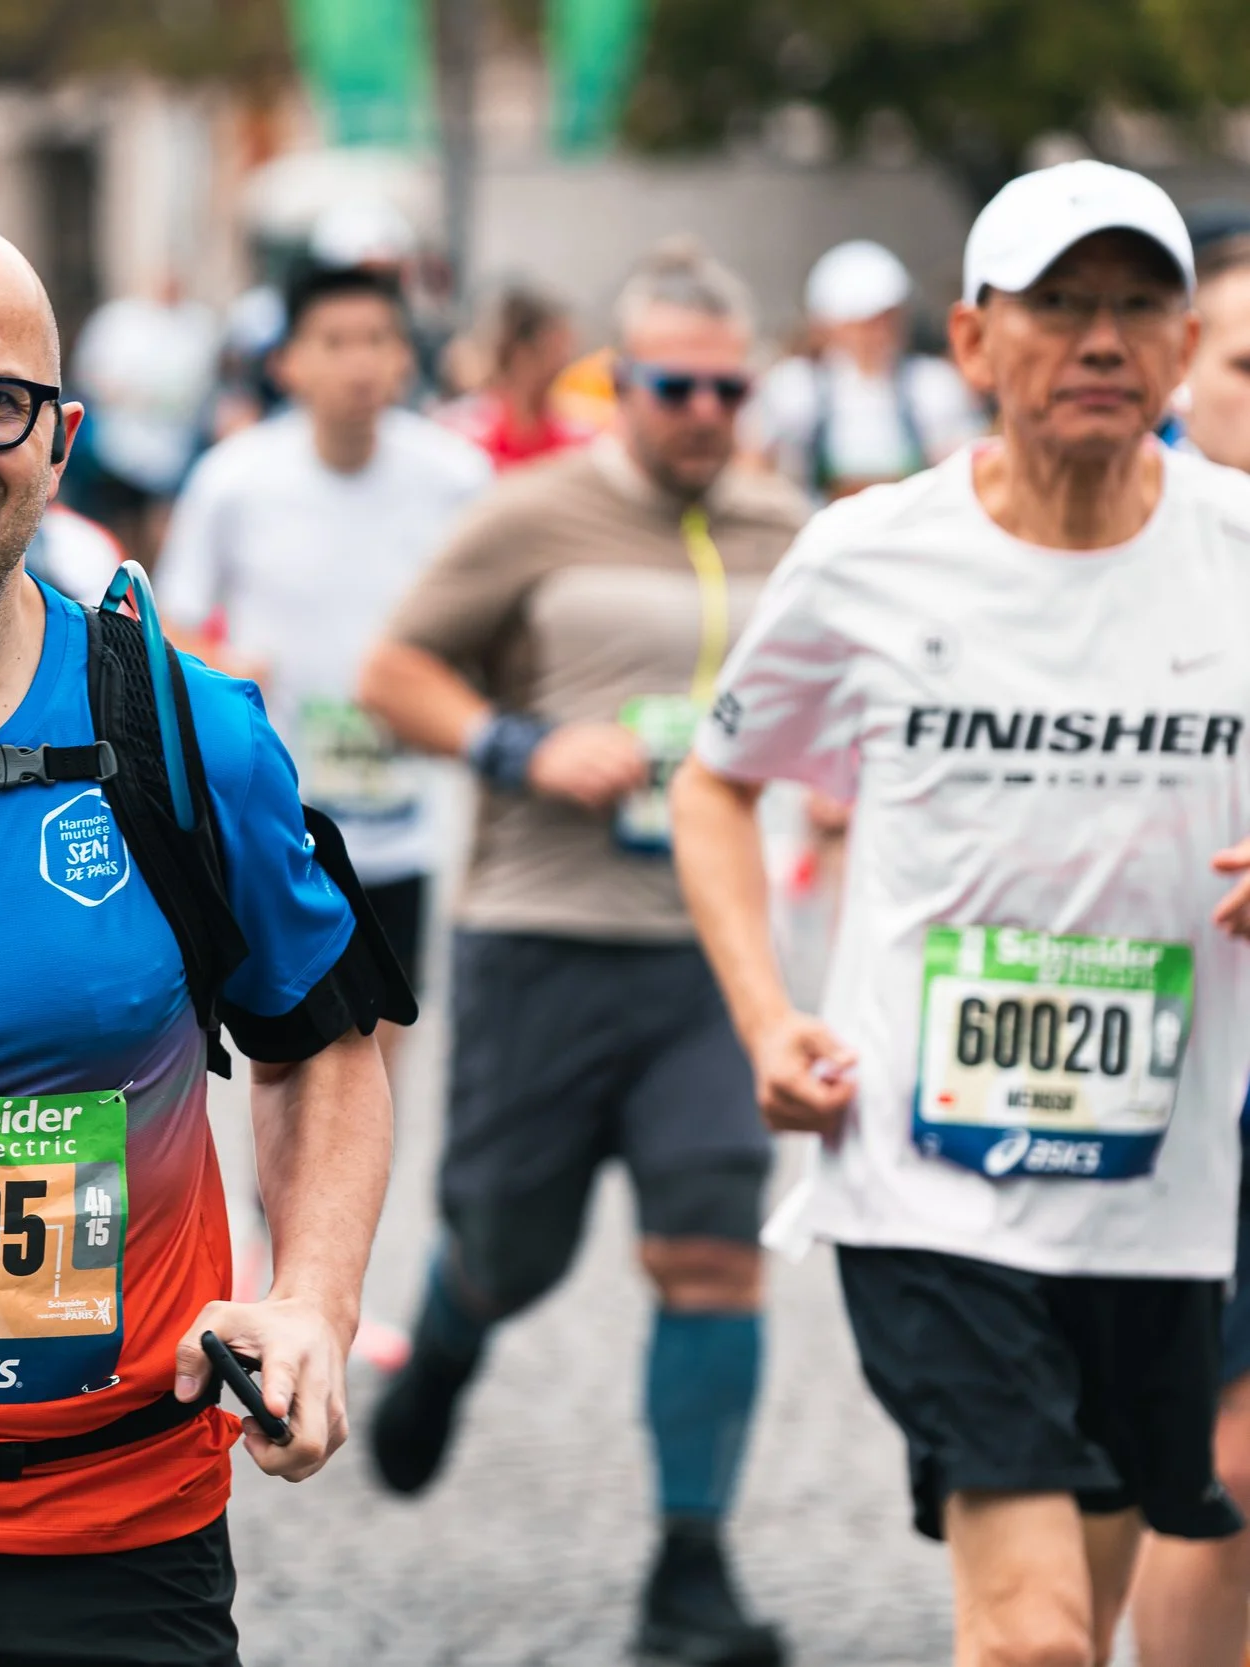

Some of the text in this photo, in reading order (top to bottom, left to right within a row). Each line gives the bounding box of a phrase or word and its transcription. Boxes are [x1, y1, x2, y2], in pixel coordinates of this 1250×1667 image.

[906, 707, 1244, 756] FINISHER
[65, 867, 85, 881] DE
[956, 996, 1131, 1077] 60020
[84, 1186, 112, 1216] 4h
[85, 1217, 110, 1246] 15
